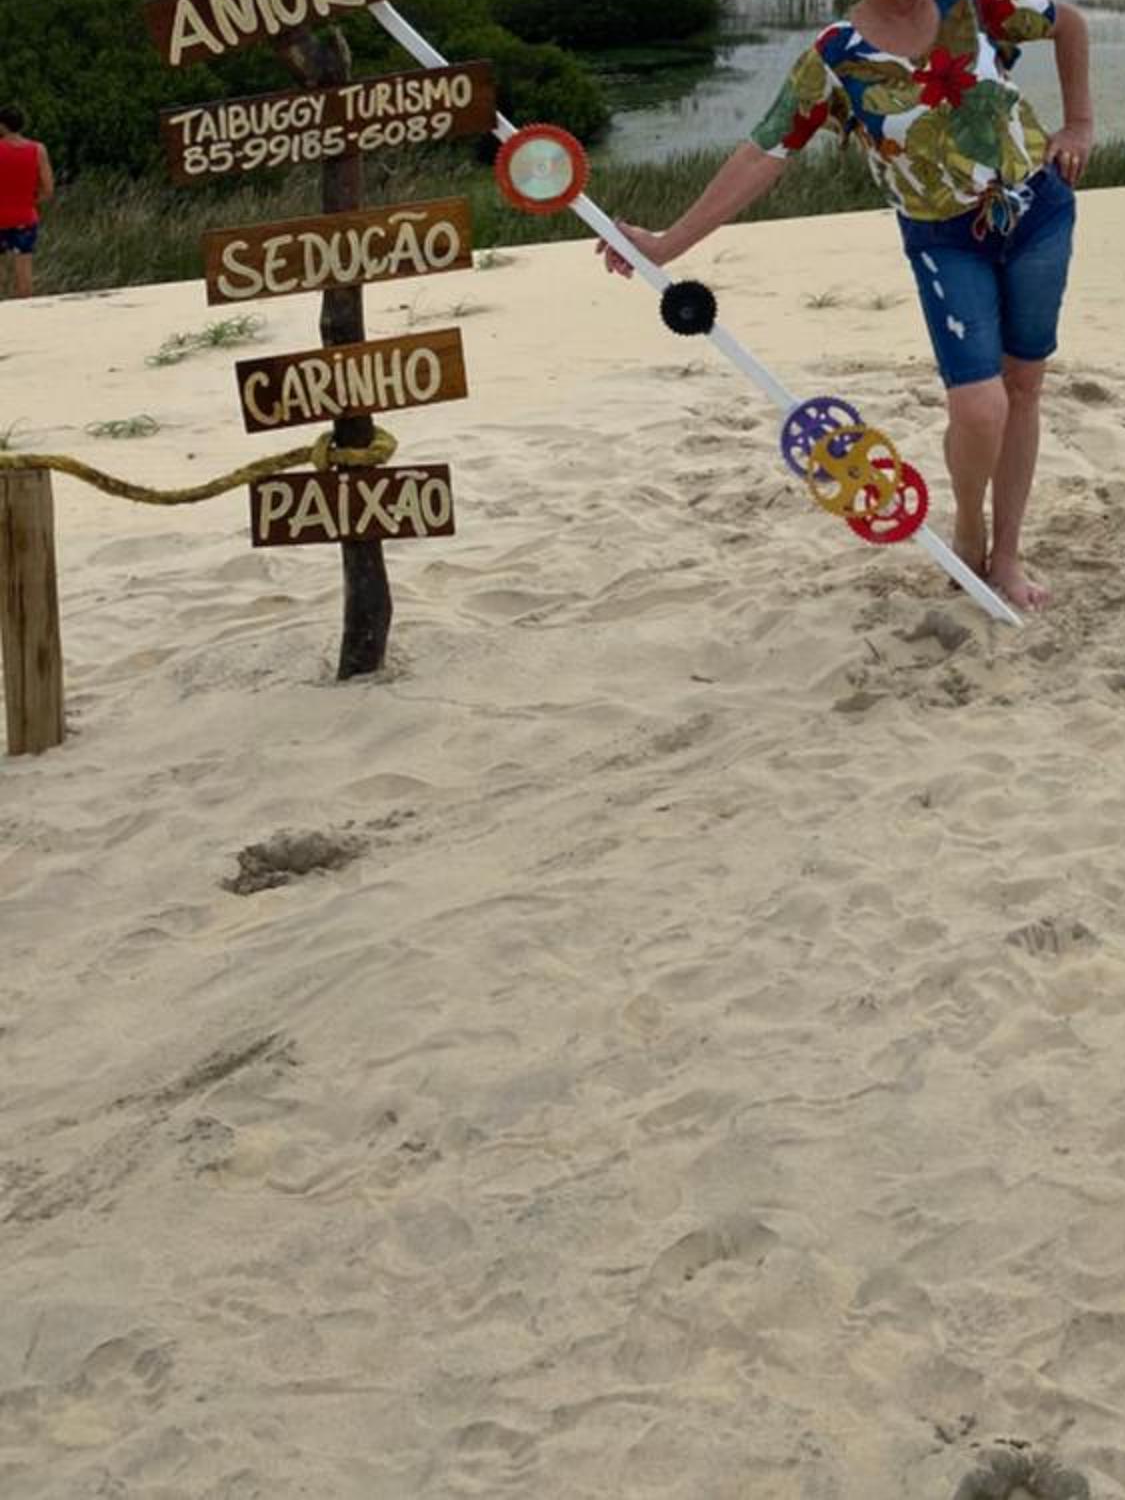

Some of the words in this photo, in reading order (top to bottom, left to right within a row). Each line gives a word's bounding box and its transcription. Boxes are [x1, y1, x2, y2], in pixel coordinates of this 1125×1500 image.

[169, 94, 326, 145] TAIBUGGY
[339, 74, 472, 121] TURISMO
[184, 112, 452, 175] 85-99185-6089
[217, 211, 460, 298] SEDUÇÃO
[243, 348, 442, 426] CARINHO
[256, 470, 451, 540] PAIXÃO
